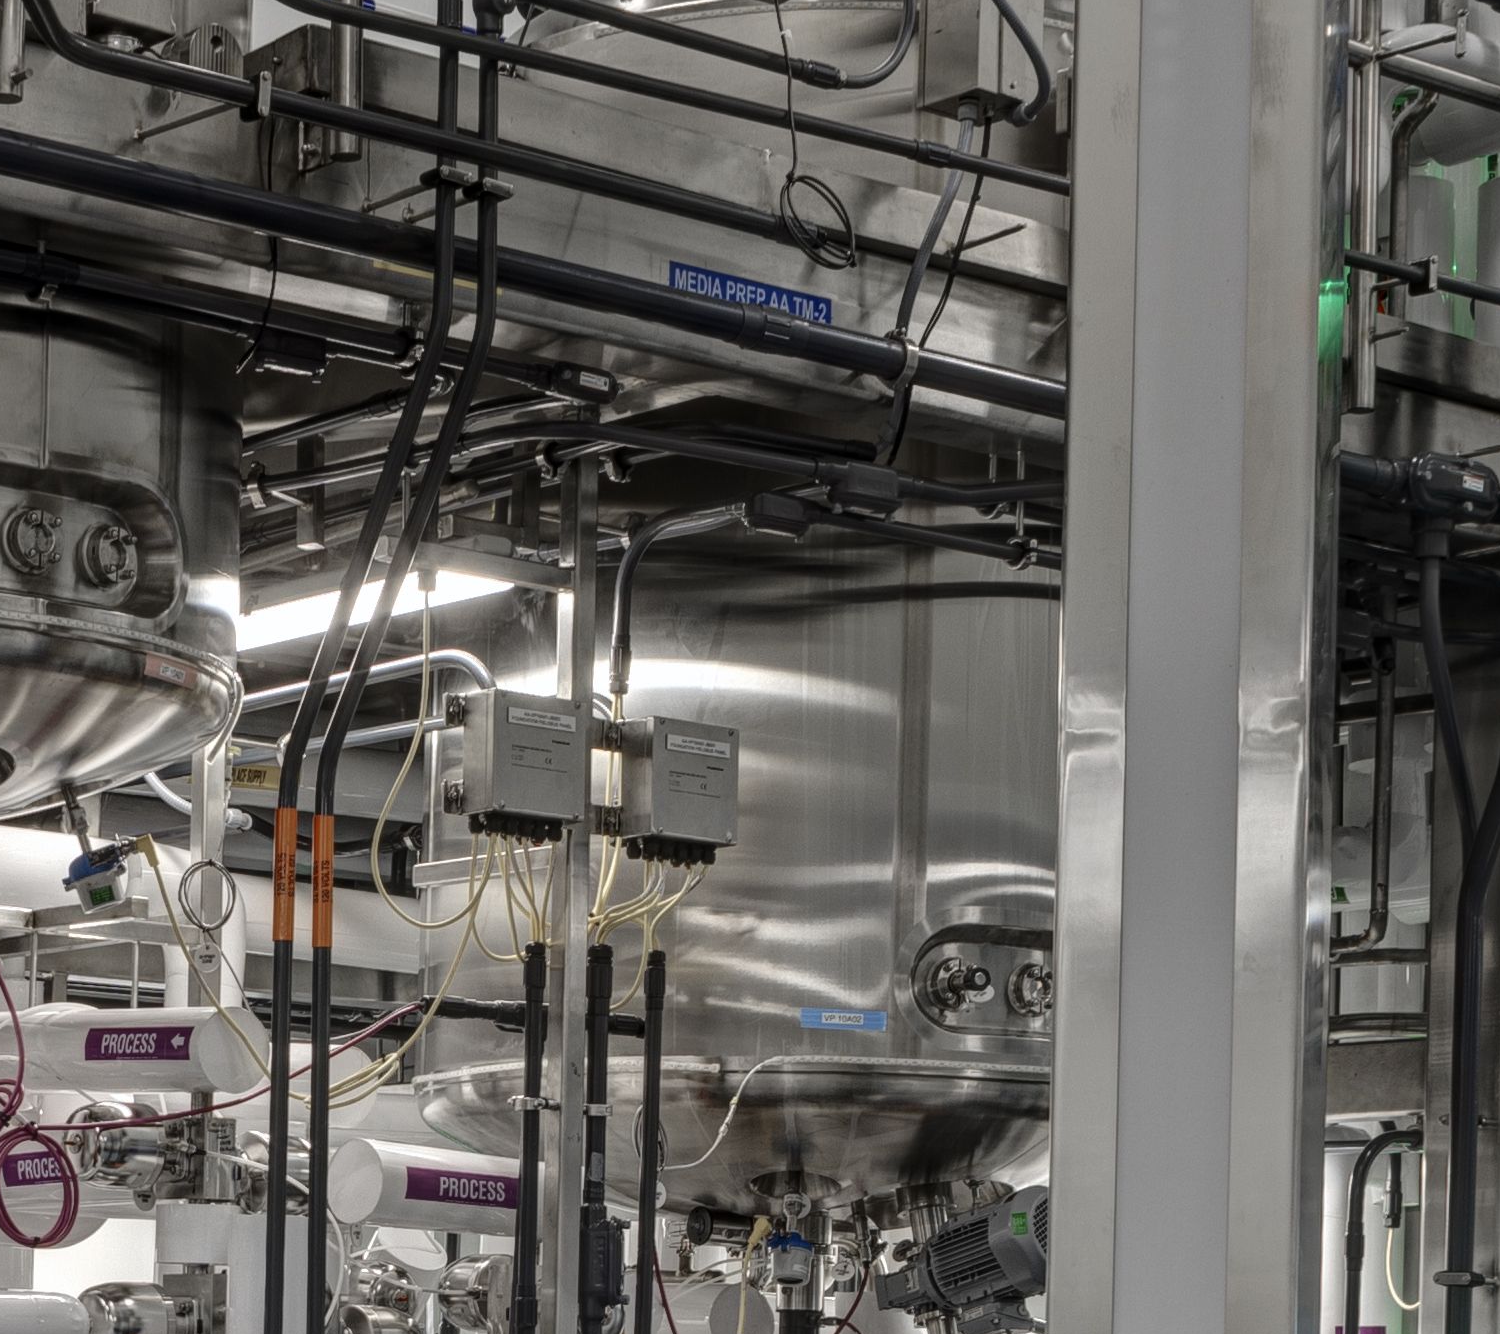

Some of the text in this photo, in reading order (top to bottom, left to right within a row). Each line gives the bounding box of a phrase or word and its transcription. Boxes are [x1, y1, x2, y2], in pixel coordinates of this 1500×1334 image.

[674, 268, 723, 300] MEDIA
[768, 291, 790, 313] AA
[792, 297, 829, 324] TM-2
[824, 1014, 836, 1022] VP
[101, 1033, 157, 1055] PROCESS
[439, 1176, 506, 1202] PROCESS
